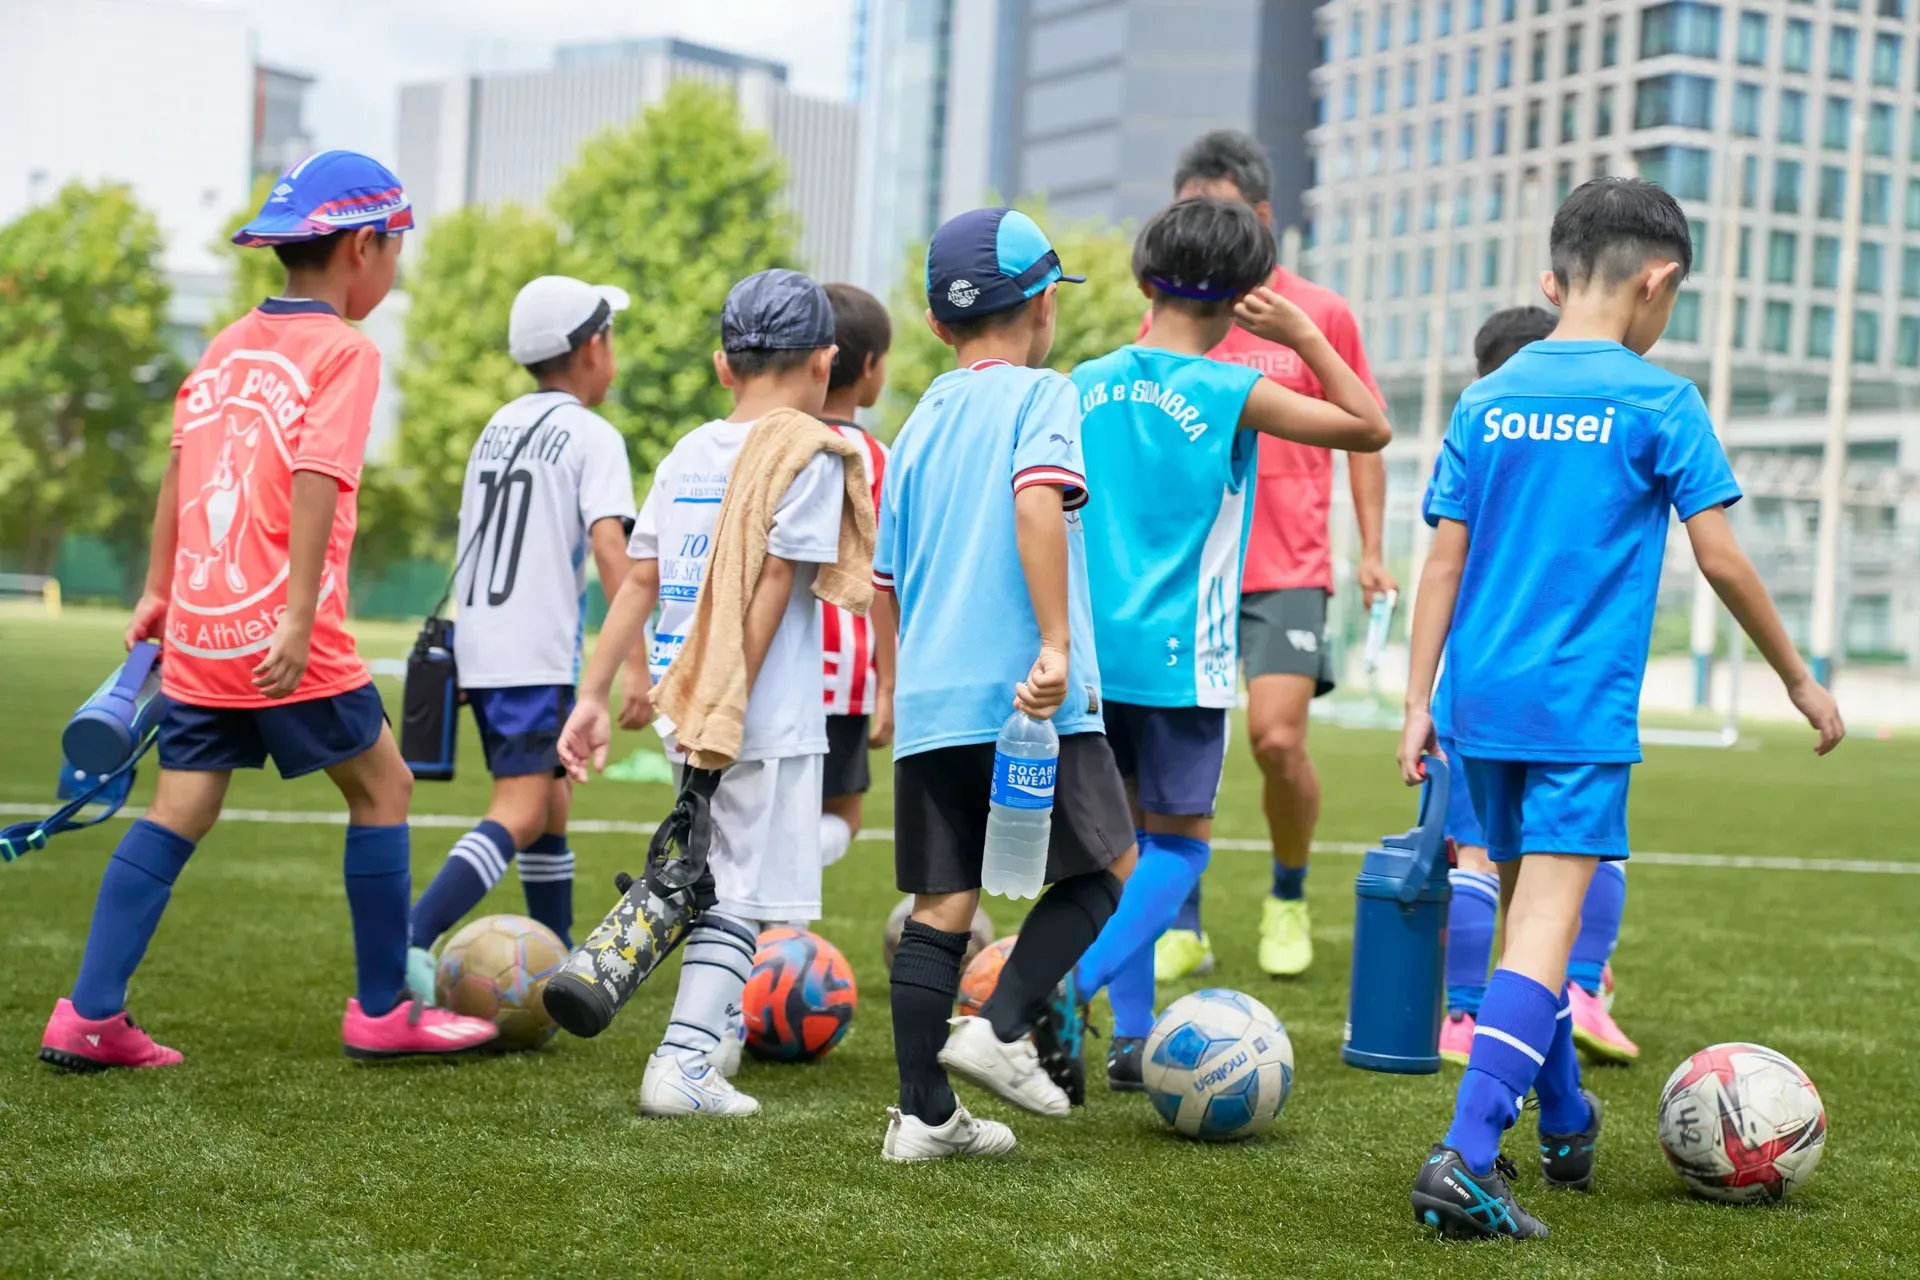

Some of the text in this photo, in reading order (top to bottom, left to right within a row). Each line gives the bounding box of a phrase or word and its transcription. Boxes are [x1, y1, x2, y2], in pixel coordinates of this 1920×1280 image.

[1130, 379, 1209, 442] SOMBRA
[1483, 406, 1616, 444] Sousei
[466, 468, 533, 606] 10
[679, 533, 710, 558] TO
[1007, 773, 1053, 786] SWEAT
[1008, 763, 1056, 777] POCARI
[1193, 1051, 1248, 1092] molten
